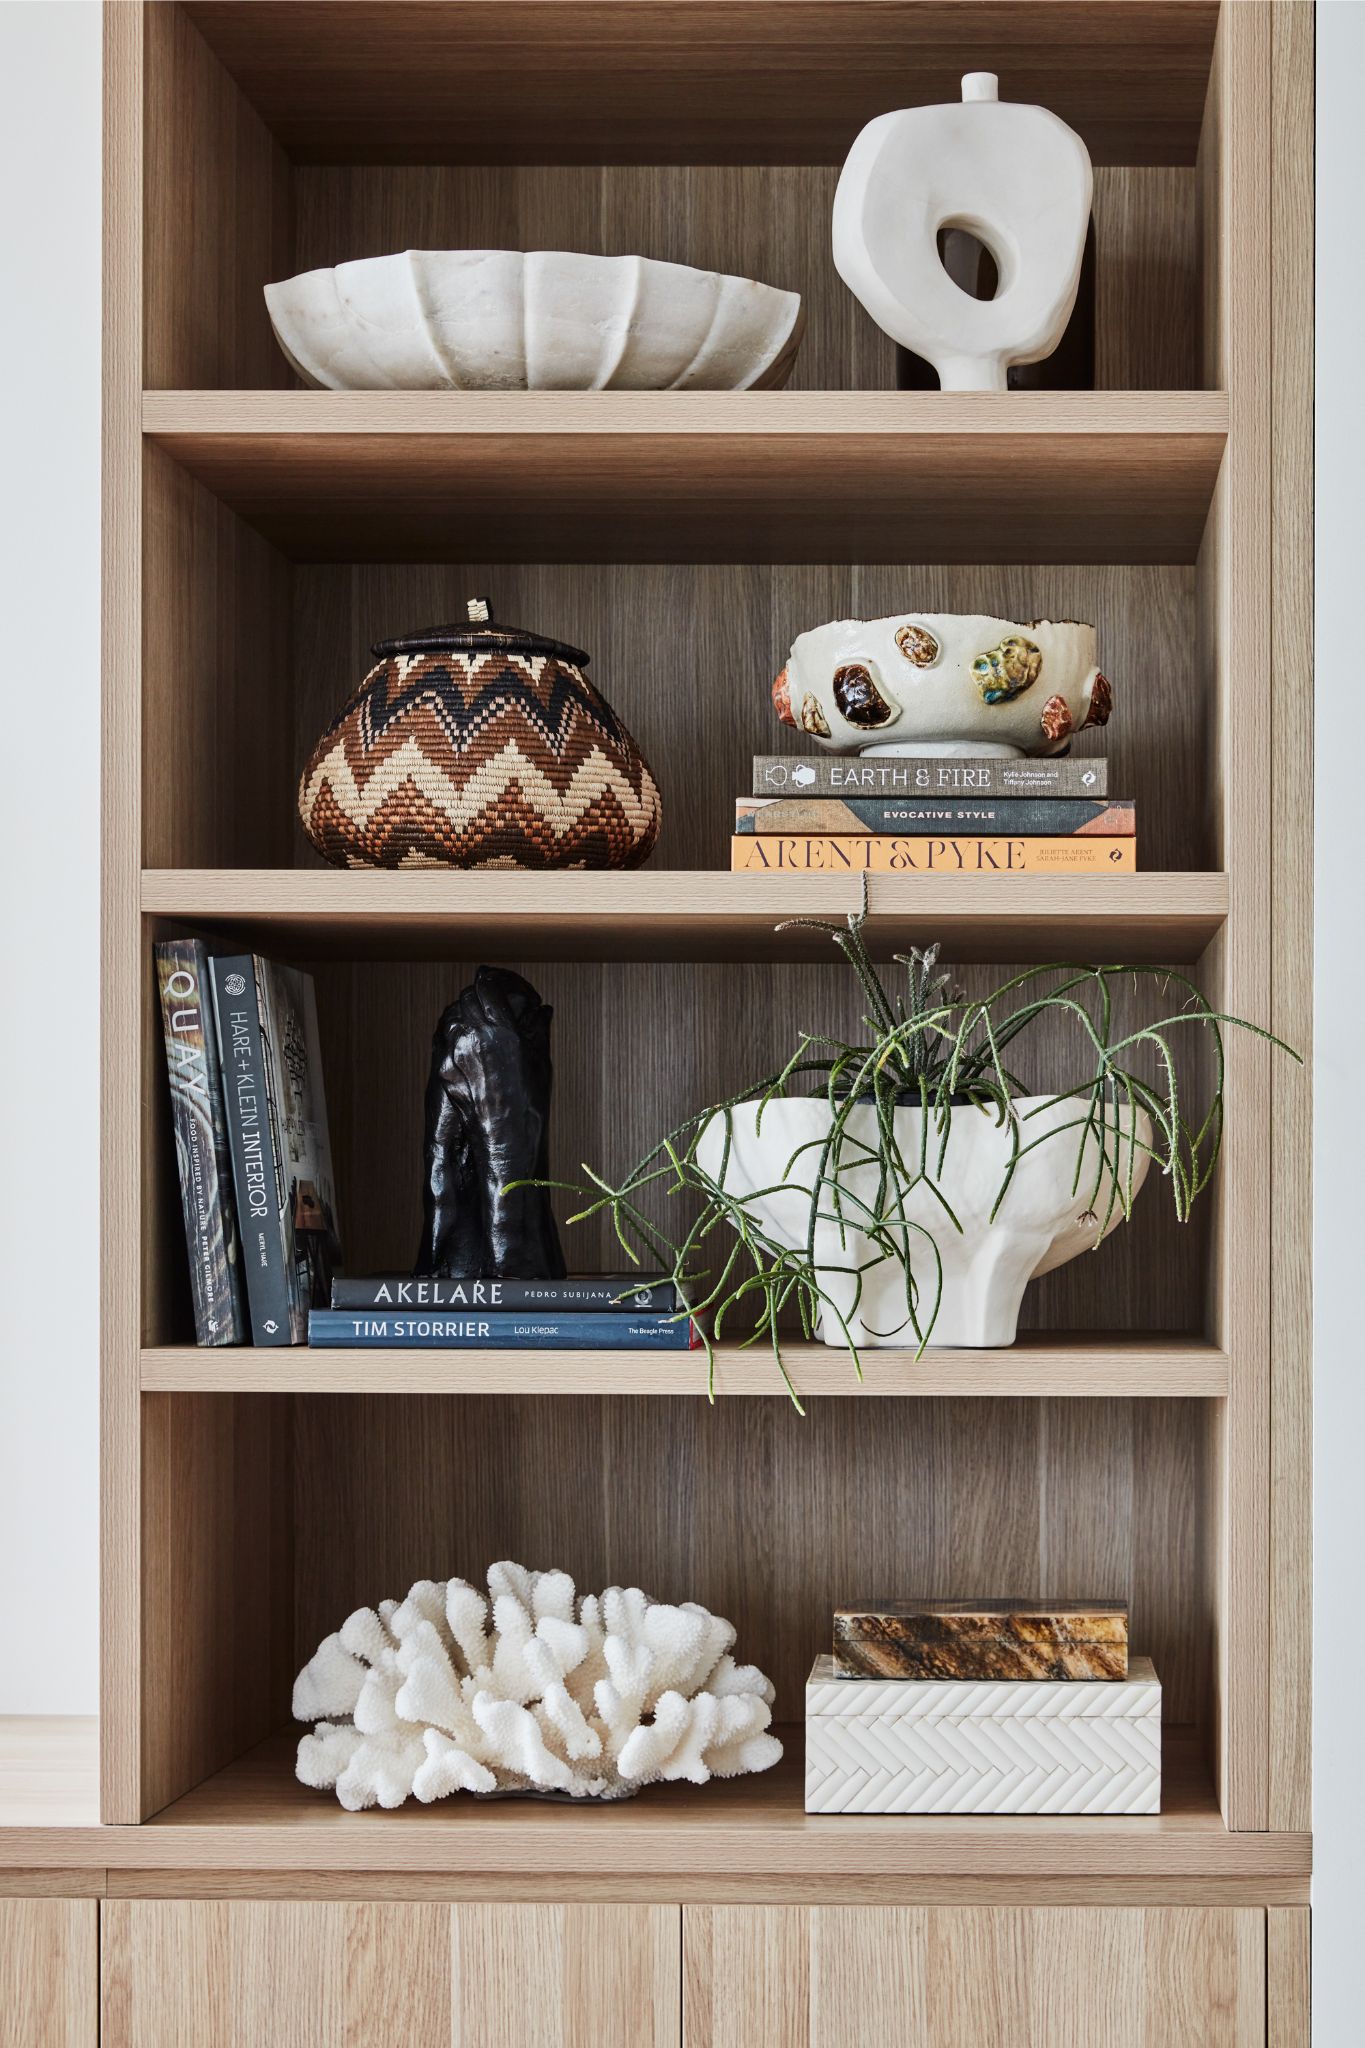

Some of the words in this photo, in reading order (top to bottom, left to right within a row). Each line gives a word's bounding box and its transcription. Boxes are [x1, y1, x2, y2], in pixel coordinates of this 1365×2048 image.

[831, 768, 907, 786] EARTH
[915, 768, 930, 787] &
[937, 769, 991, 787] FIRE
[1003, 771, 1019, 779] Kylie
[884, 811, 952, 819] EVOCATIVE
[957, 811, 995, 819] STYLE
[744, 840, 881, 869] ARENT
[889, 840, 920, 870] &
[925, 840, 1026, 870] PYKE
[163, 970, 206, 1095] QUAY
[230, 1011, 252, 1058] HARE
[238, 1059, 250, 1071] +
[237, 1073, 259, 1127] KLEIN
[190, 1118, 198, 1142] FOOD
[192, 1144, 202, 1183] INSPIRED
[242, 1131, 268, 1218] INTERIOR
[196, 1185, 203, 1195] BY
[198, 1198, 207, 1231] NATURE
[202, 1236, 210, 1262] PETER
[258, 1232, 266, 1251] MERYL
[260, 1251, 268, 1268] HARE
[204, 1264, 214, 1302] GILMORE
[563, 1291, 612, 1300] SUBIJANA
[352, 1321, 387, 1336] TIM
[394, 1321, 490, 1337] STORRIER
[514, 1326, 530, 1334] Lou
[531, 1326, 559, 1335] Klepac
[639, 1327, 657, 1335] Beagle
[658, 1327, 674, 1335] Press
